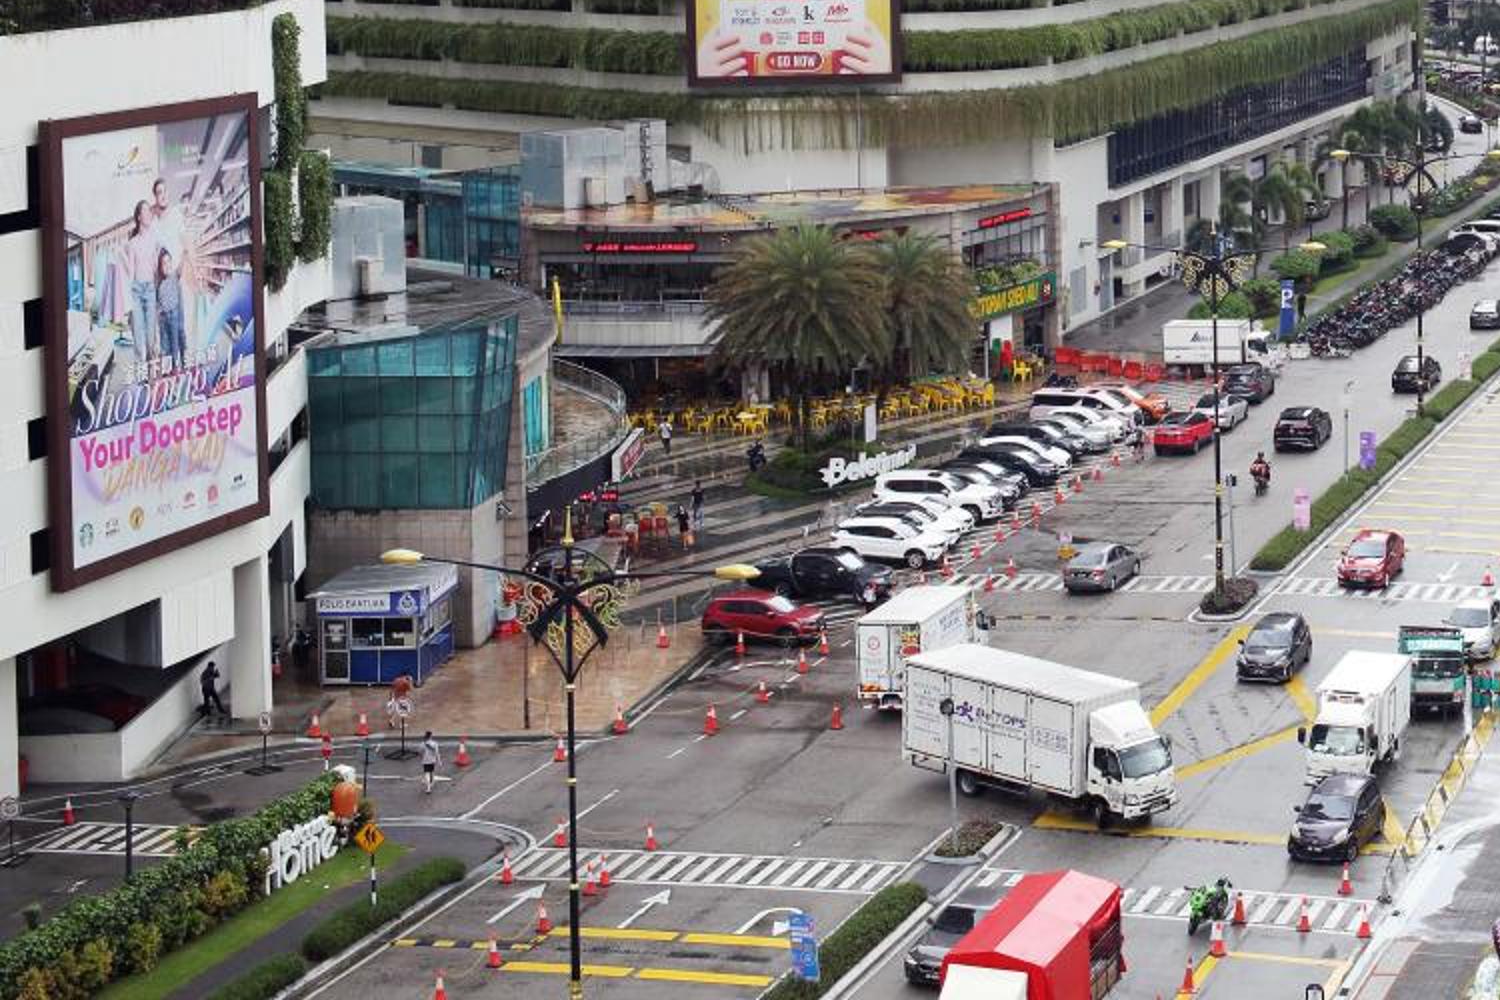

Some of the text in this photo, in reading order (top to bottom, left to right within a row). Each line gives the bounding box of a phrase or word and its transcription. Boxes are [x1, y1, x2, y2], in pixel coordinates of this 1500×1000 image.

[76, 367, 207, 436] Shopping
[79, 403, 242, 472] Your Doorstep
